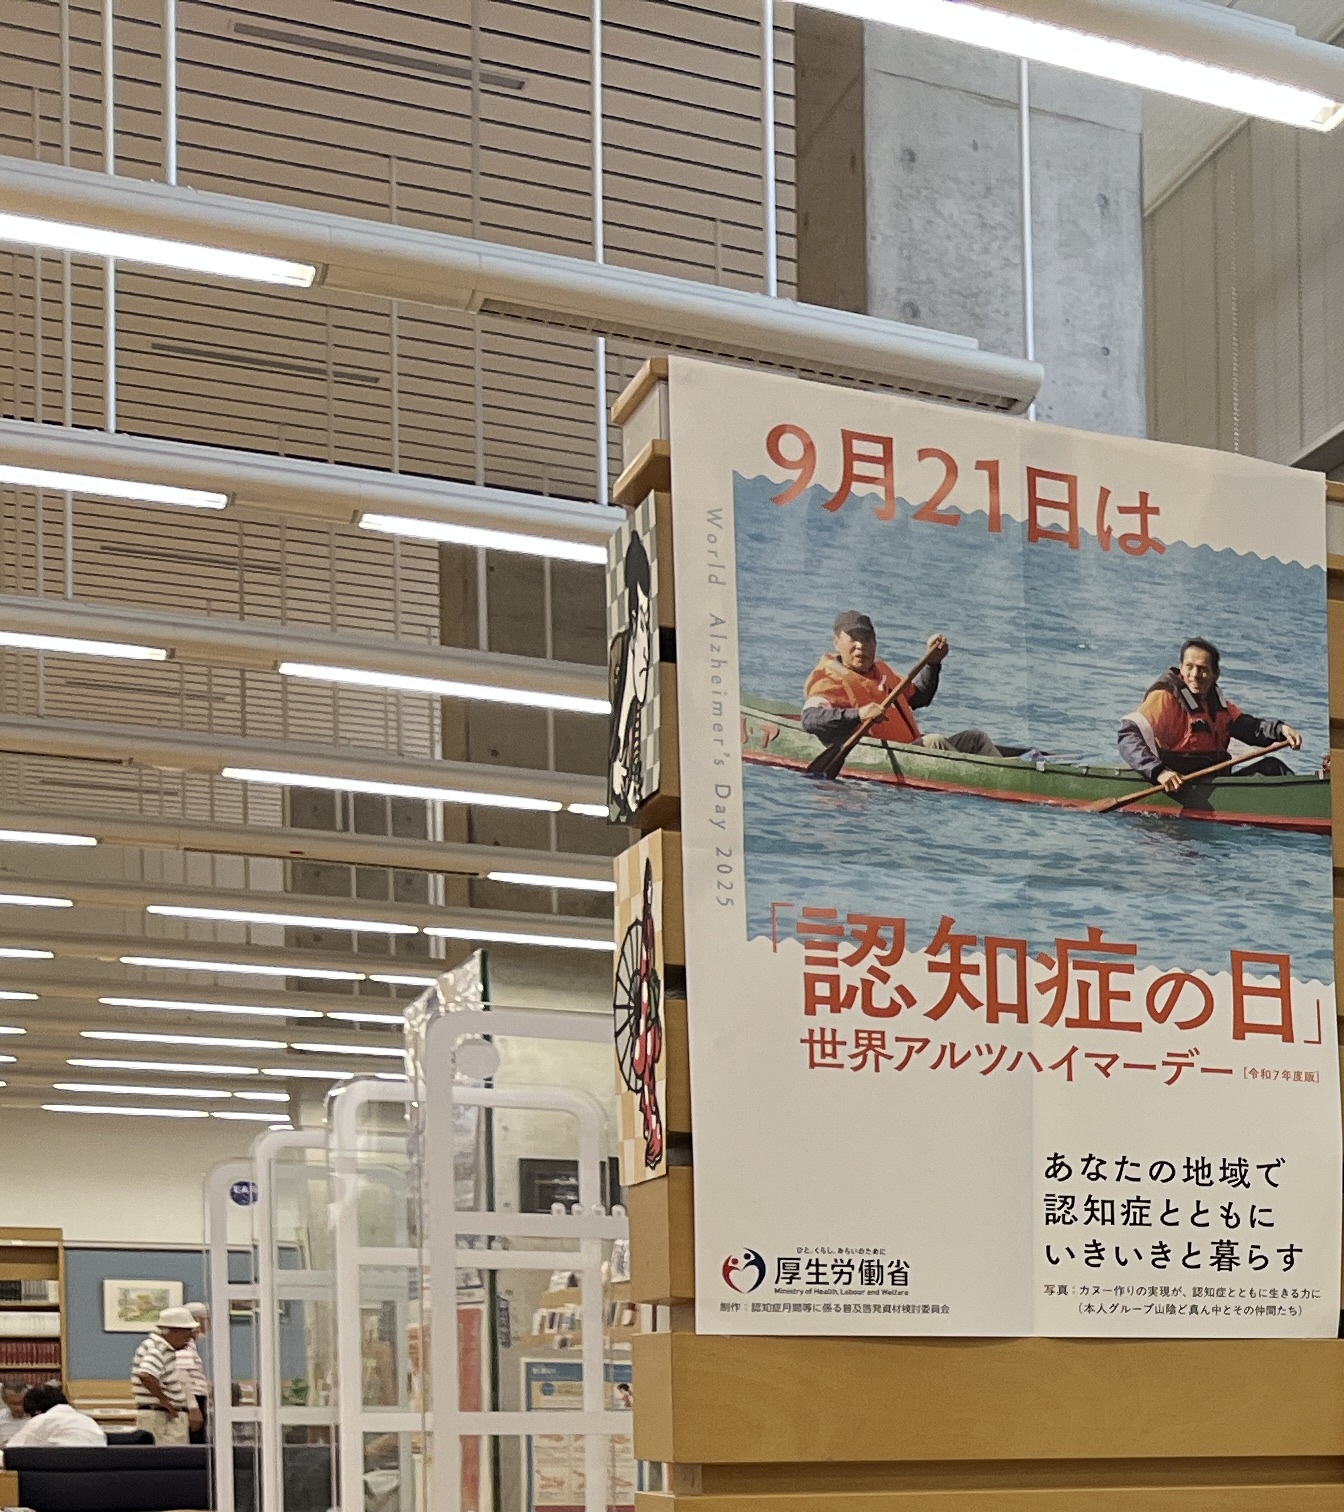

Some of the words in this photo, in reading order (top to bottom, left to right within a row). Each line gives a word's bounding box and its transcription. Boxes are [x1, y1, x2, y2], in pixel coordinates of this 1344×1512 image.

[766, 424, 1166, 556] 9月21日は
[705, 506, 725, 586] World
[709, 612, 727, 768] Alzheimer's
[714, 782, 731, 831] Day
[715, 847, 734, 908] 2025
[770, 902, 1324, 1046] 「認知症の日」
[800, 1028, 1233, 1085] 世界アルツハイマーデー
[1044, 1152, 1285, 1188] あなたの地域で
[1044, 1193, 1274, 1229] 認知症とともに
[775, 1257, 910, 1286] 厚生労働省
[1046, 1239, 1302, 1271] いきいきと暮らす
